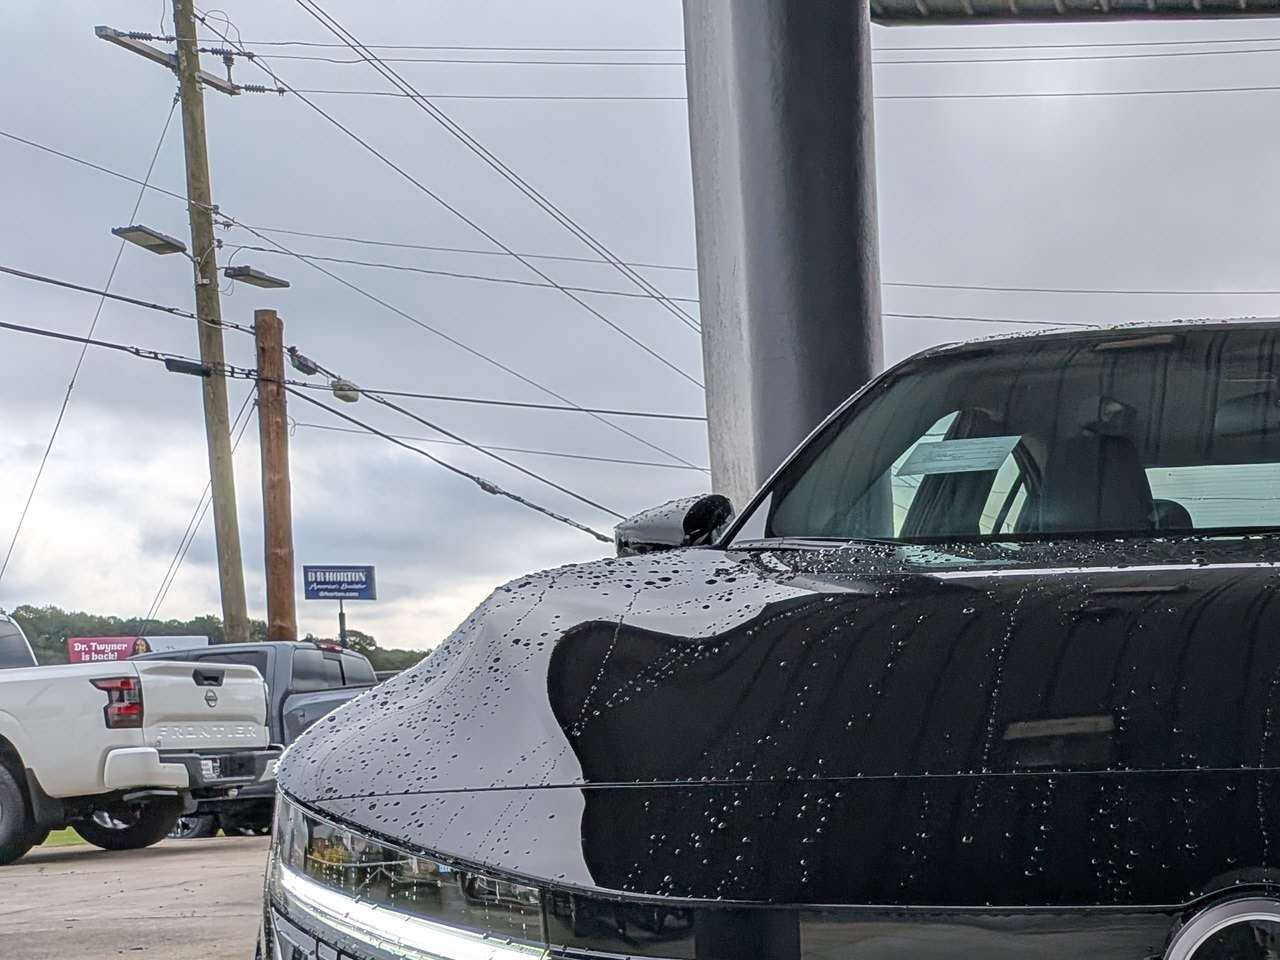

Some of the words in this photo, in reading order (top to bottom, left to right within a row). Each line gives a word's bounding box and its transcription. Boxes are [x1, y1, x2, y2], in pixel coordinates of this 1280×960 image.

[74, 643, 88, 651] Dr.
[91, 642, 127, 652] Twyner
[82, 652, 89, 661] is
[91, 652, 117, 661] back!
[160, 726, 257, 739] FRONTIER
